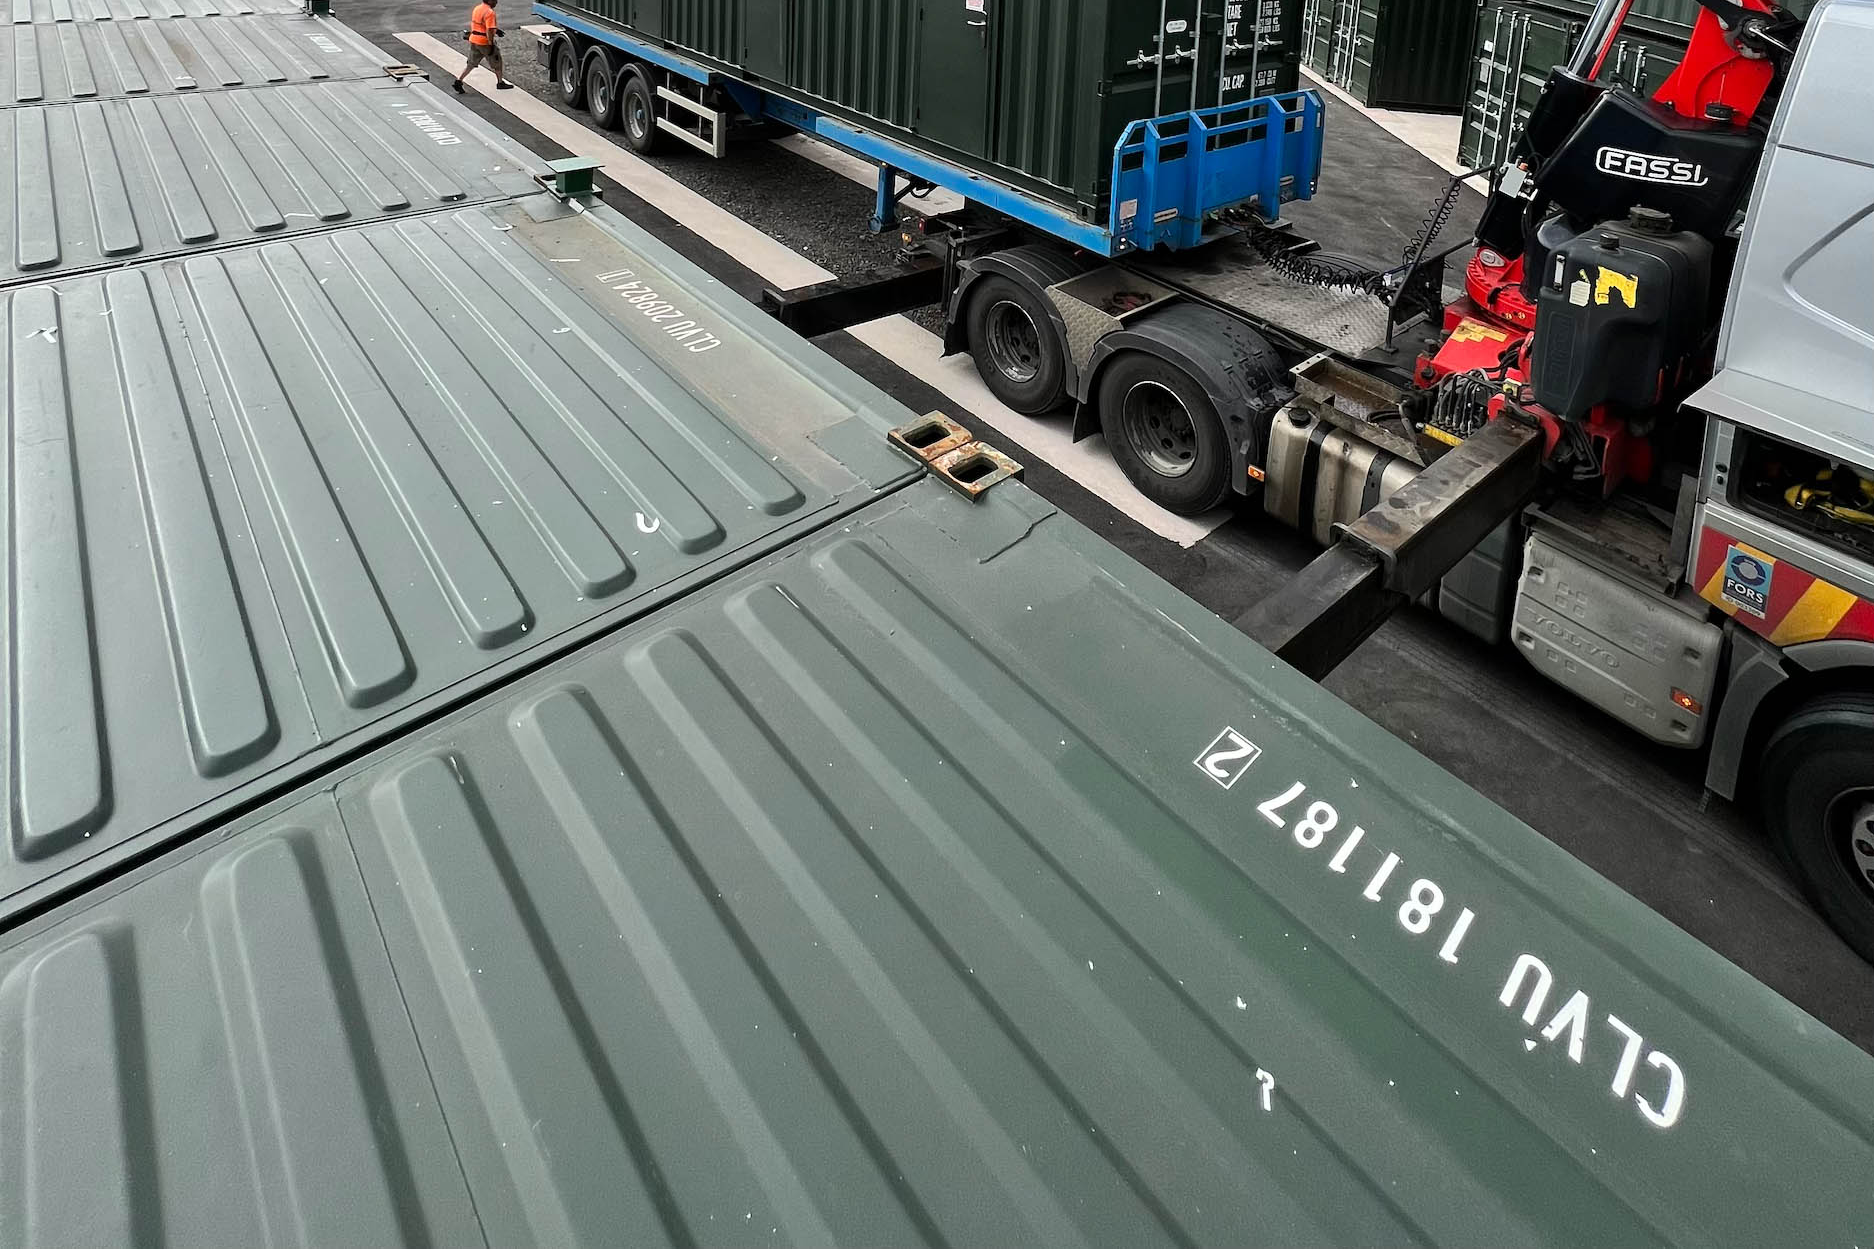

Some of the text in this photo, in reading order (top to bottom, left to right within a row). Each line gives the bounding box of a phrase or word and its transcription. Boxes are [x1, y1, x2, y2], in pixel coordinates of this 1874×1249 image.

[1604, 151, 1701, 182] FASSI
[612, 280, 685, 323] 209824
[662, 320, 721, 353] CLVU
[1727, 578, 1764, 604] FORS
[1202, 730, 1686, 1128] CLVU 181187 2
